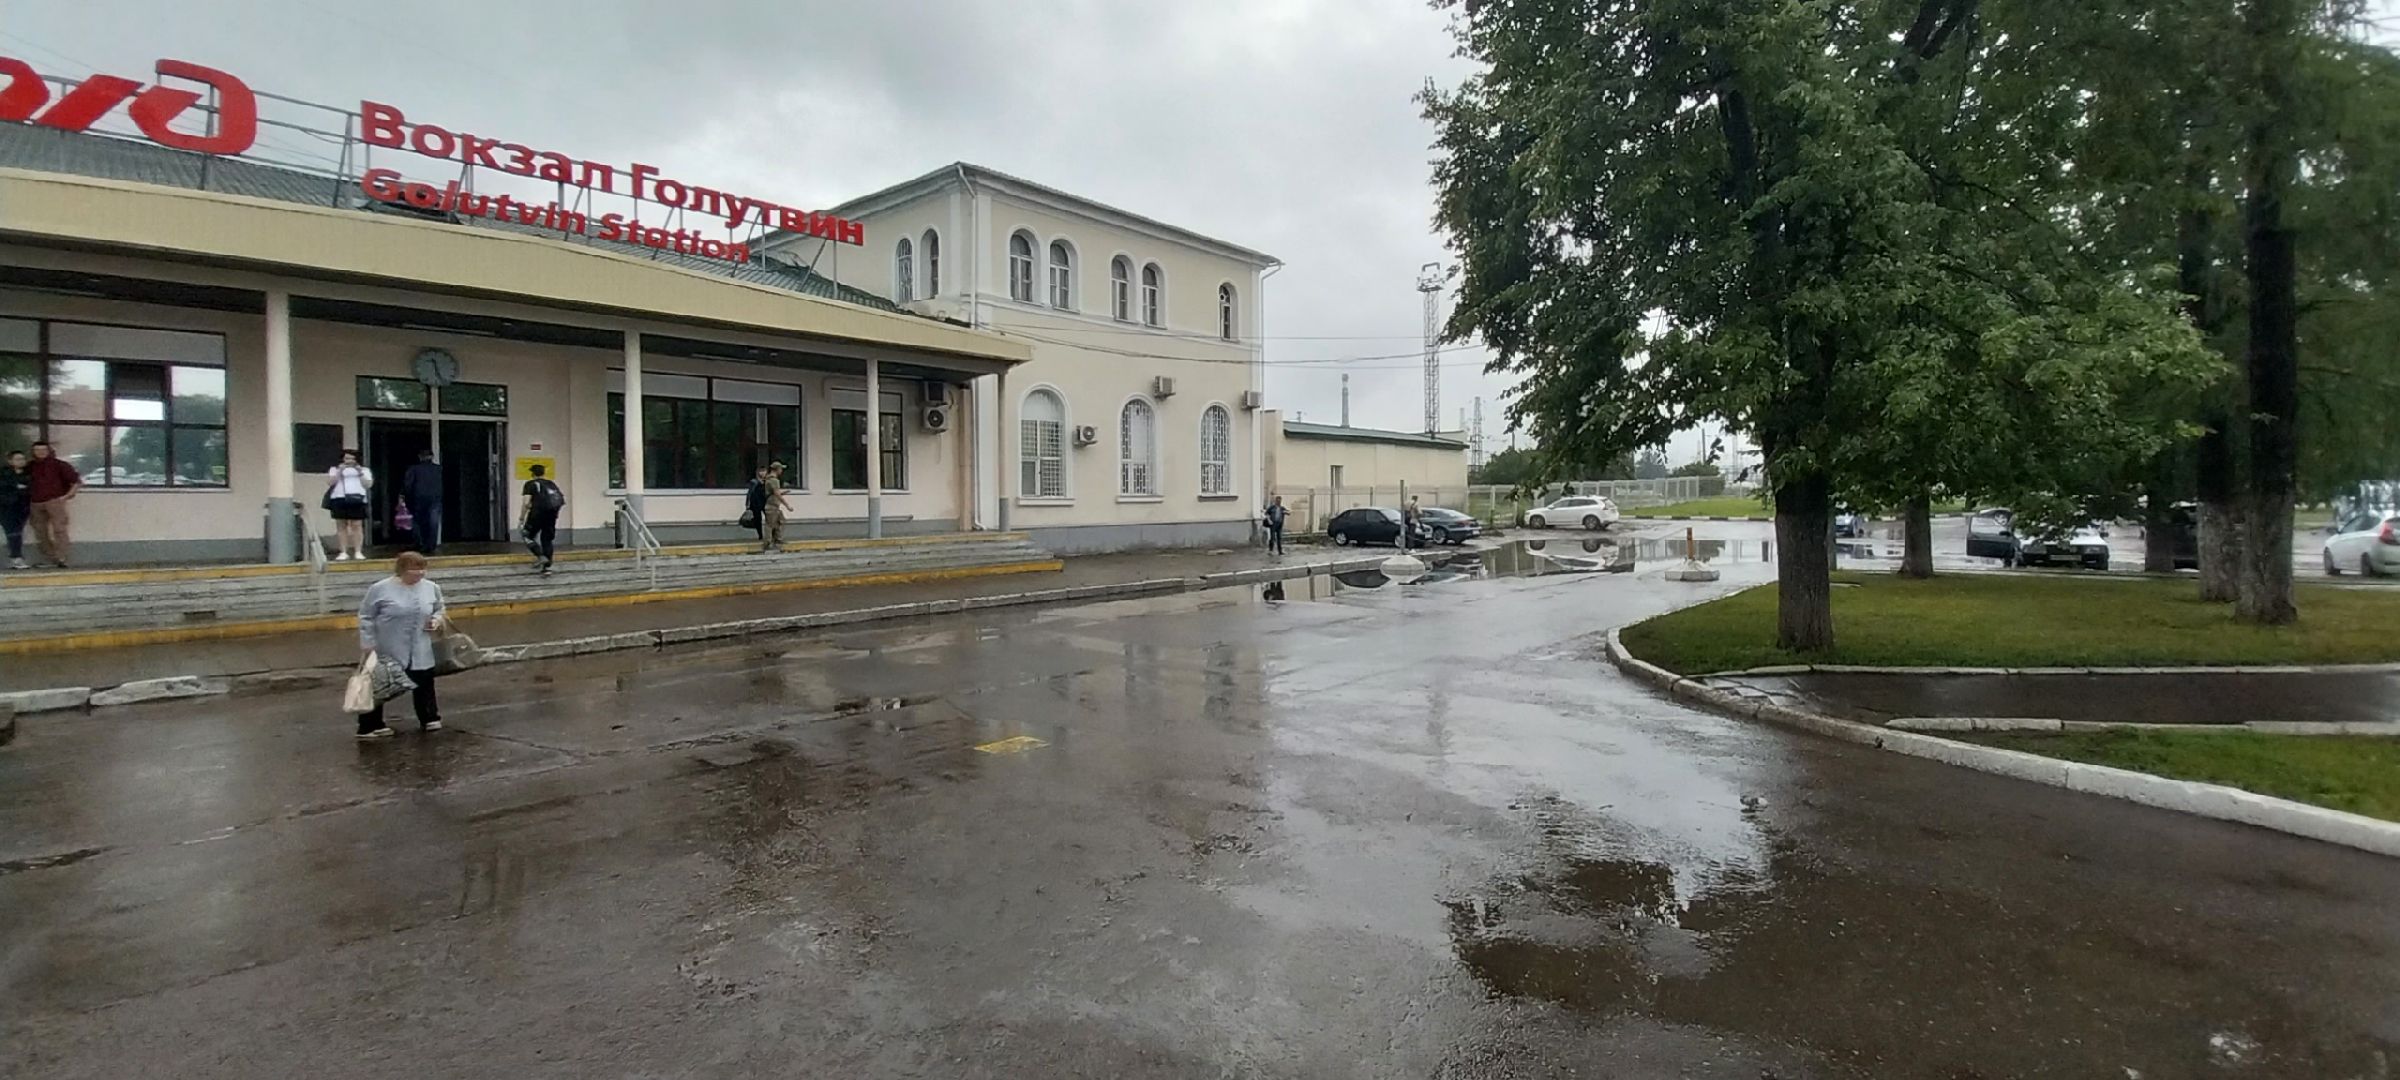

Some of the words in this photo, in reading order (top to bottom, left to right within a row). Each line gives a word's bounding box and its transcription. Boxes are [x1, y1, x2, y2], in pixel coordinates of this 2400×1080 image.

[360, 100, 613, 194] Вокзал
[631, 163, 864, 247] Голутвин
[361, 168, 586, 235] Golutvin
[598, 213, 749, 264] Station
